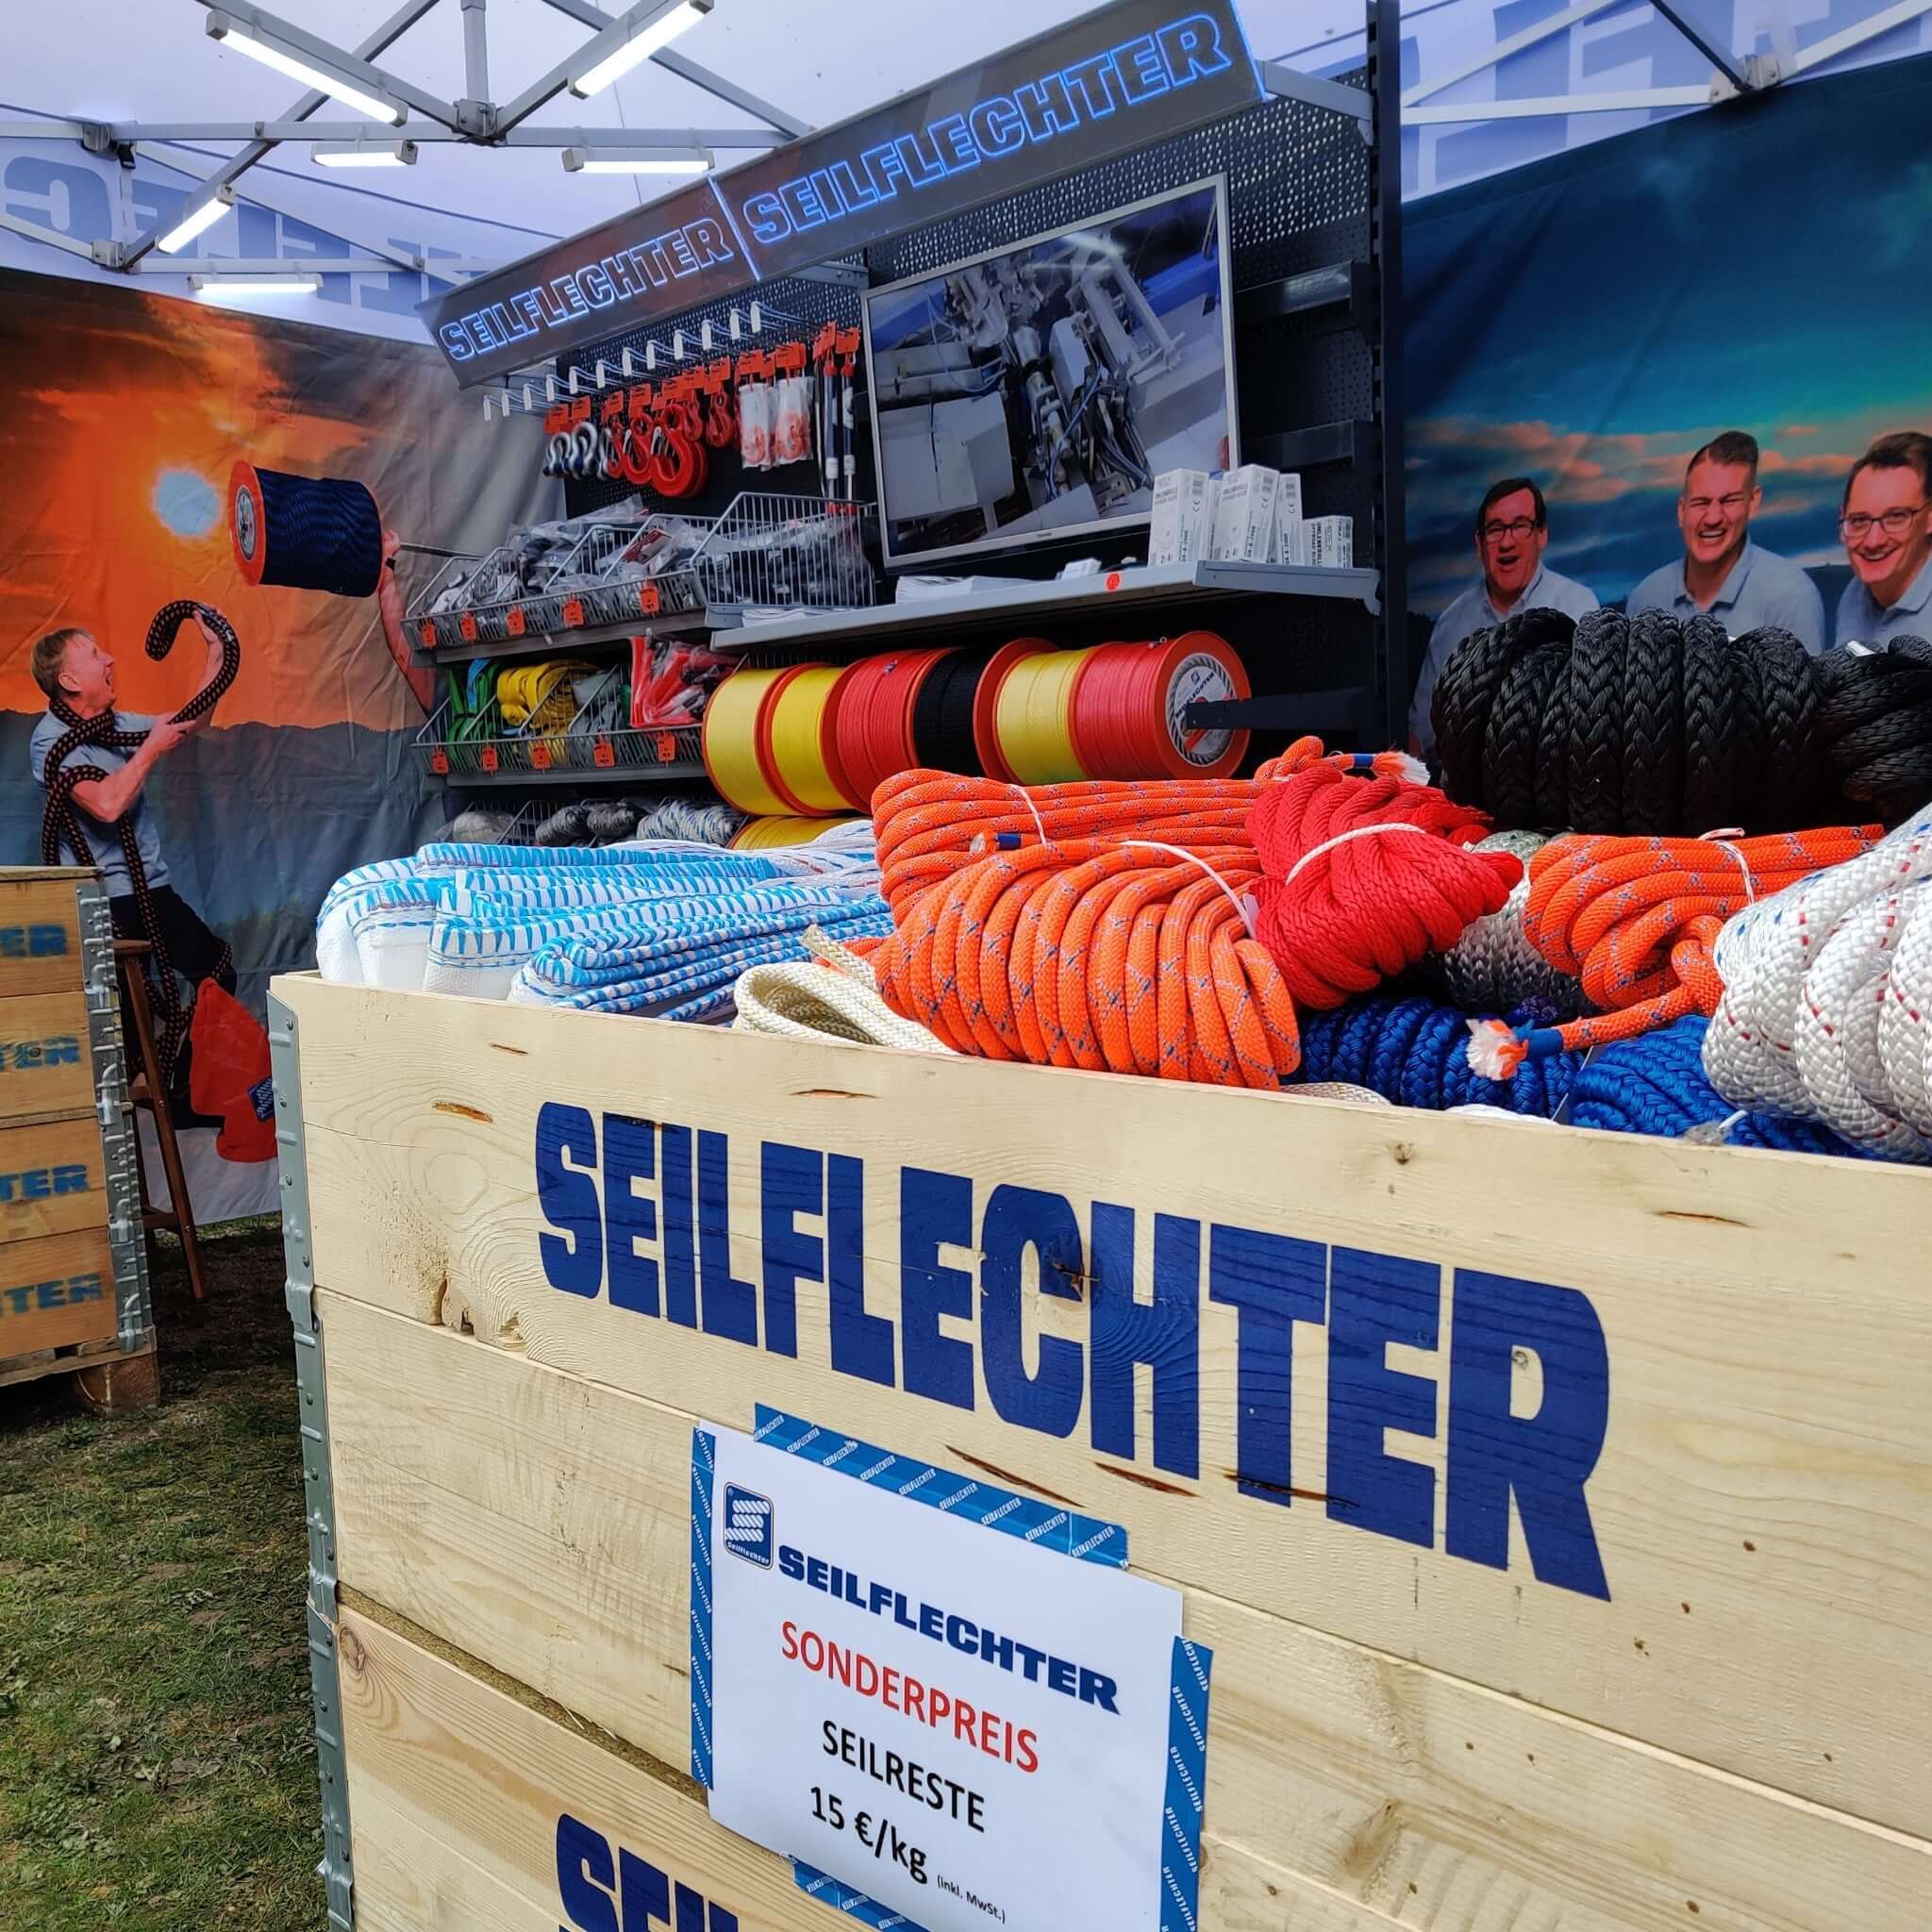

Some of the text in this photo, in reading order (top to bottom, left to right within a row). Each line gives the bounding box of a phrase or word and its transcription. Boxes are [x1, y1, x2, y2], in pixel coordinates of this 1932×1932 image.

[743, 12, 1232, 244] SEILFLECHTER
[439, 218, 734, 360] SEILFLECHTER
[0, 1037, 81, 1072] ER
[0, 1274, 103, 1316] TER
[536, 1101, 1612, 1604] SEILFLECHTER
[939, 1482, 978, 1510] SEILFLECHTER
[980, 1497, 1022, 1525] SEILFLECHTER
[1024, 1512, 1068, 1541] SEILFLECHTER
[1071, 1525, 1116, 1558] SEILFLECHTER
[778, 1544, 1121, 1715] SEILFLECHTER
[782, 1621, 1040, 1774] SONDERPREIS
[1172, 1686, 1206, 1752] SEILFLECHTER
[823, 1720, 985, 1833] SEILRESTE
[1170, 1746, 1203, 1812] SEILFLECHTER
[810, 1787, 845, 1830] 15
[854, 1811, 928, 1885] €/kg
[966, 1890, 1006, 1924] MwSt.)
[1165, 1807, 1198, 1873] SEILFLECHTER
